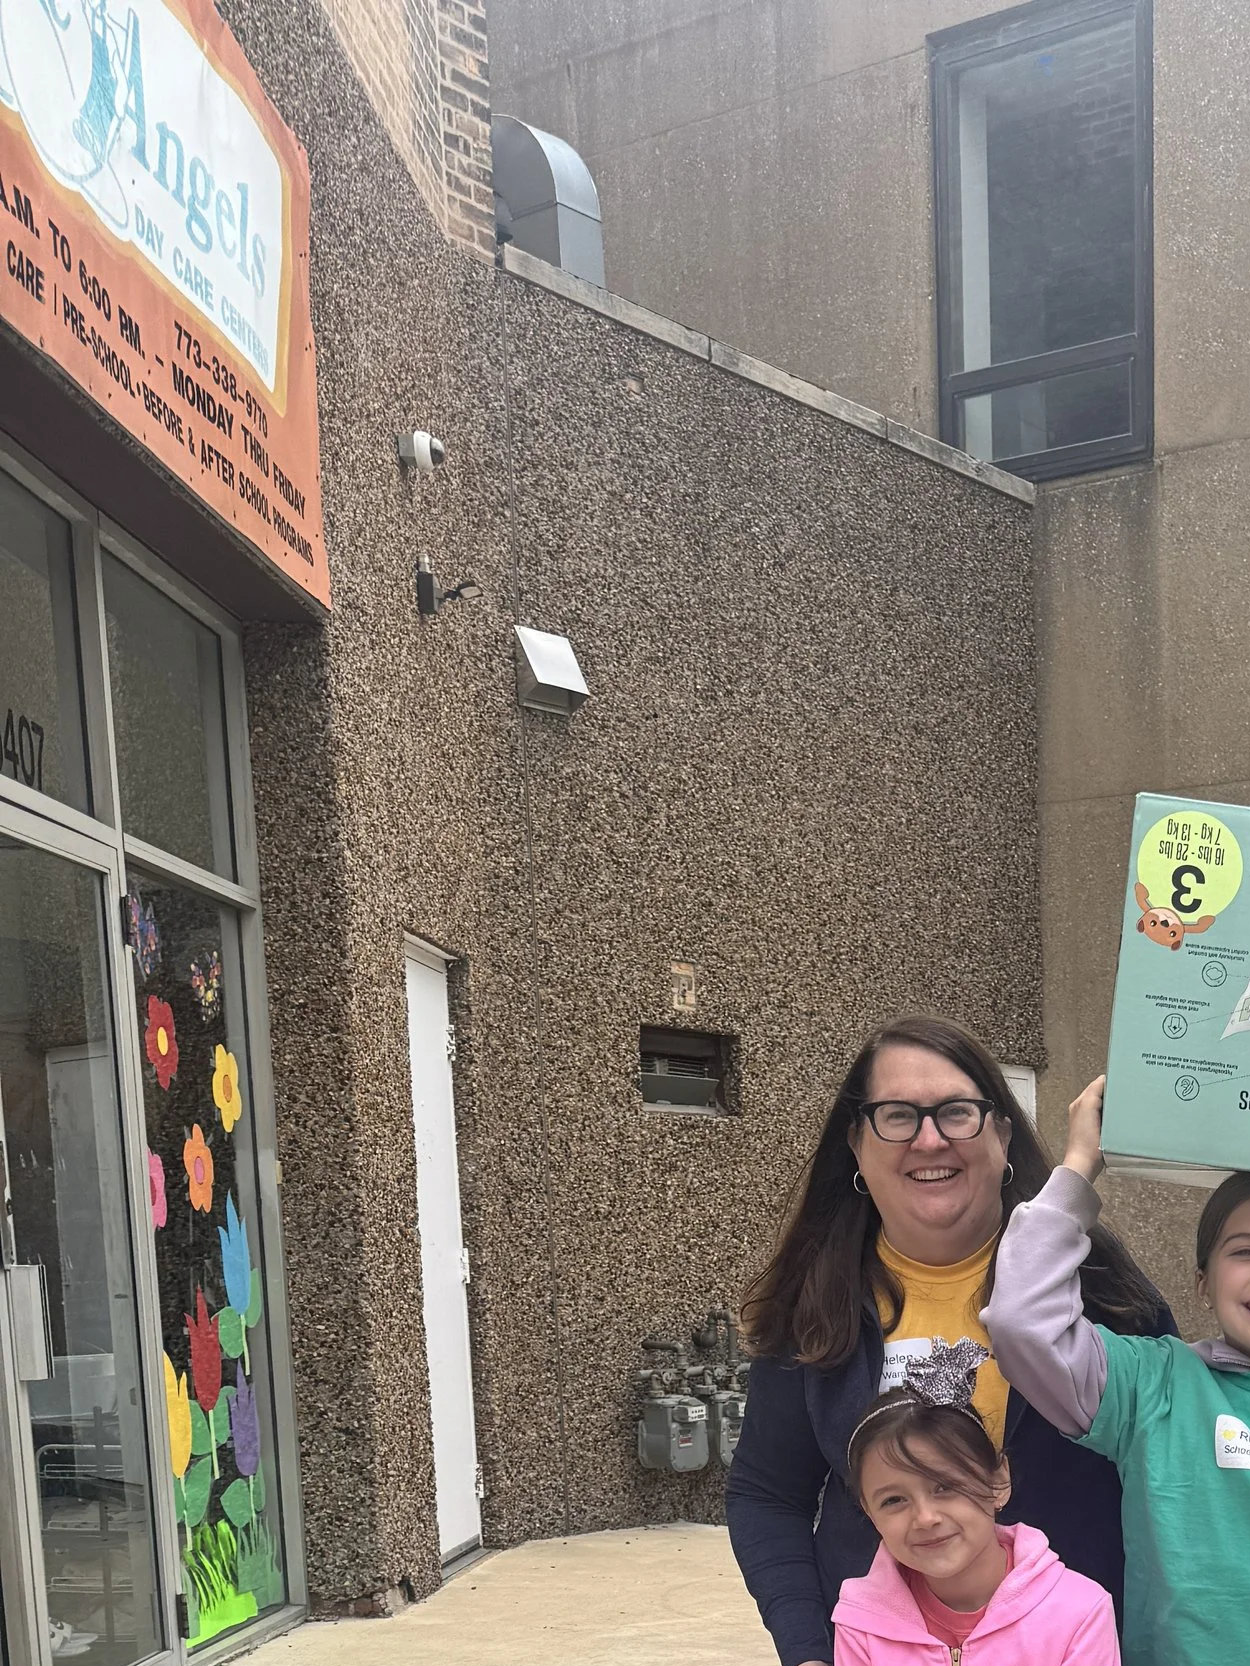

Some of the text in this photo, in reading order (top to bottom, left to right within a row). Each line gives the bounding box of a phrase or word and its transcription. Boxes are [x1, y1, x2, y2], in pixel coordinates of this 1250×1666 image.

[114, 7, 267, 299] Angels
[135, 203, 164, 259] DAY
[173, 245, 214, 312] CARE
[7, 240, 45, 305] CARE
[62, 292, 135, 399] PRE-SCHOOL
[142, 381, 184, 446] BEFORE
[188, 426, 196, 457] &
[201, 439, 235, 490] AFTER
[239, 471, 272, 525] SCHOOL
[273, 506, 314, 567] PROGRAMS
[48, 217, 71, 272] TO
[79, 259, 111, 322] 6:00
[172, 361, 234, 440] MONDAY
[241, 424, 269, 478] THRU
[273, 462, 305, 519] FRIDAY
[174, 320, 268, 439] 773-338-9770
[0, 708, 44, 791] 407
[1158, 840, 1225, 866] 16 lbs 28 lbs
[1167, 818, 1221, 846] 7 kg 13 kg
[1171, 865, 1205, 914] 3
